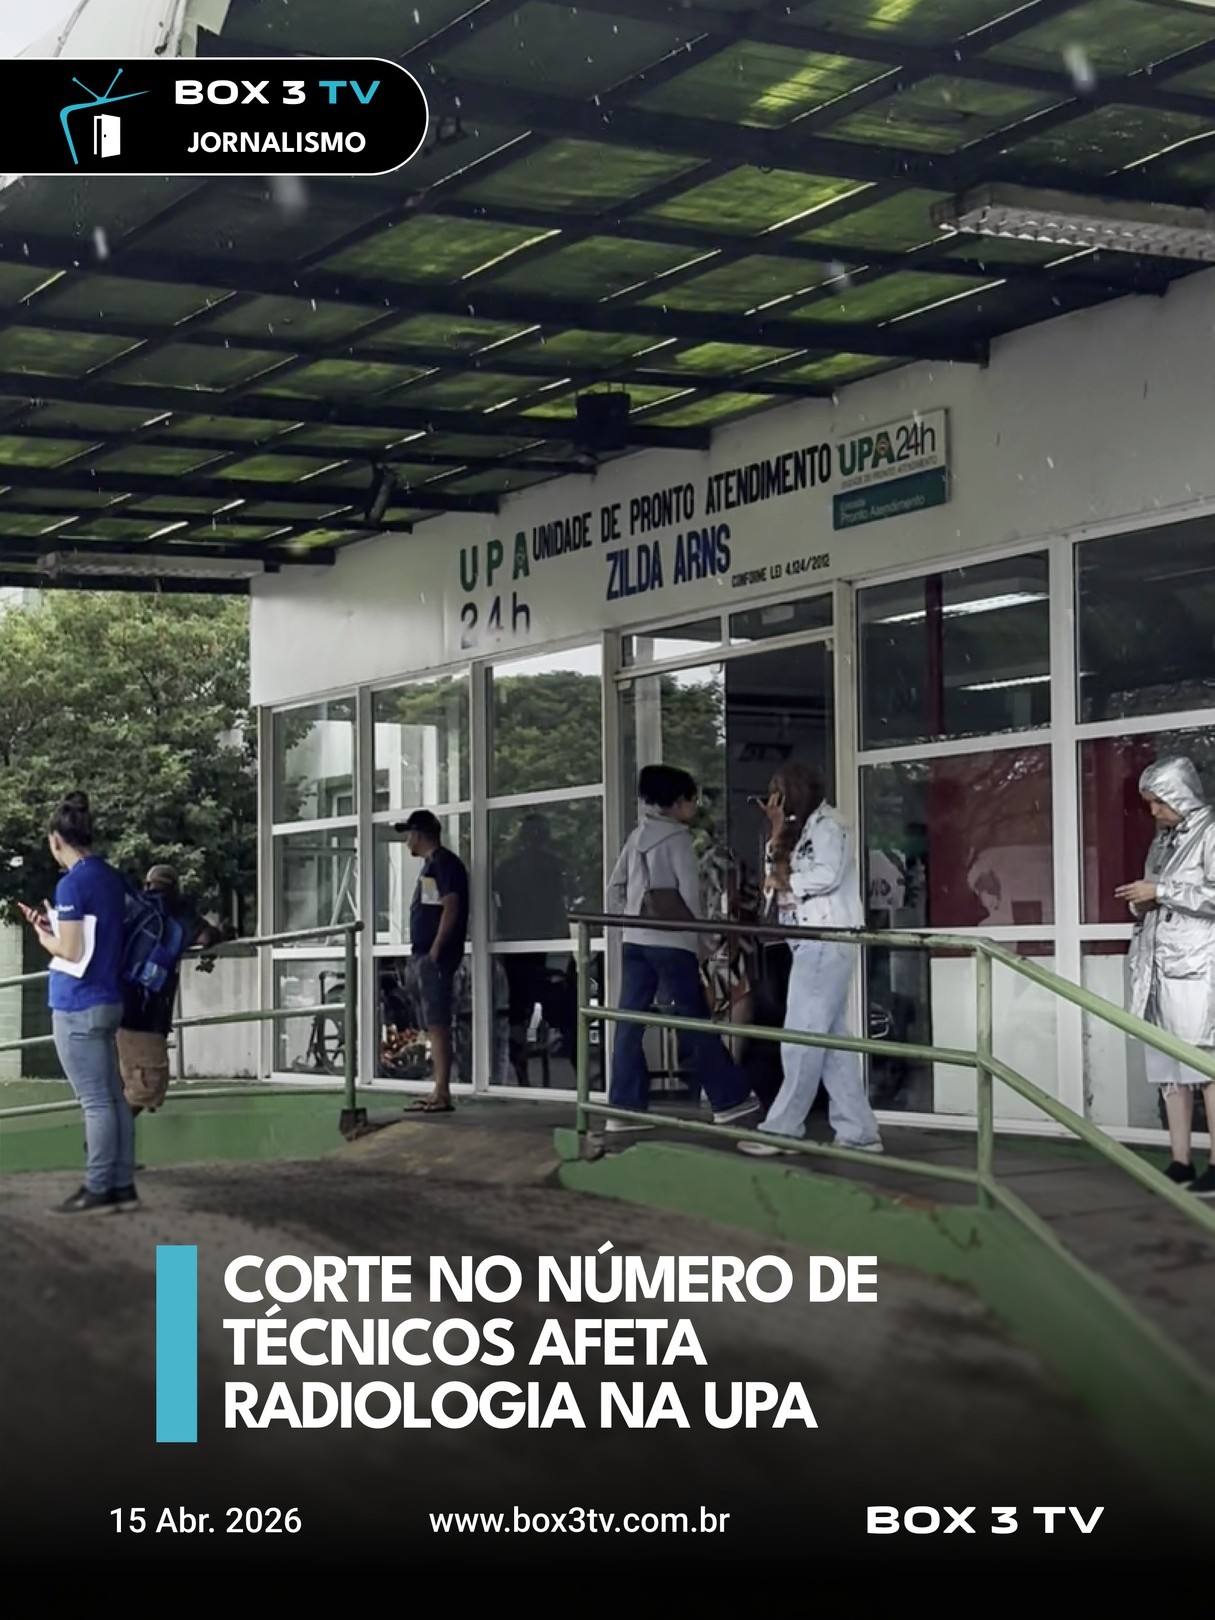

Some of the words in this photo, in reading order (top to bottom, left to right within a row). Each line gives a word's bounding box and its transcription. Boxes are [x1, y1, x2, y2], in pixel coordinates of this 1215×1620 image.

[532, 512, 593, 561] UNIDADE
[601, 503, 622, 543] DE
[630, 483, 695, 535] PRONTO
[705, 443, 832, 515] ATENDIMENTO
[606, 540, 664, 601] ZILDA
[673, 523, 731, 585] ARNS
